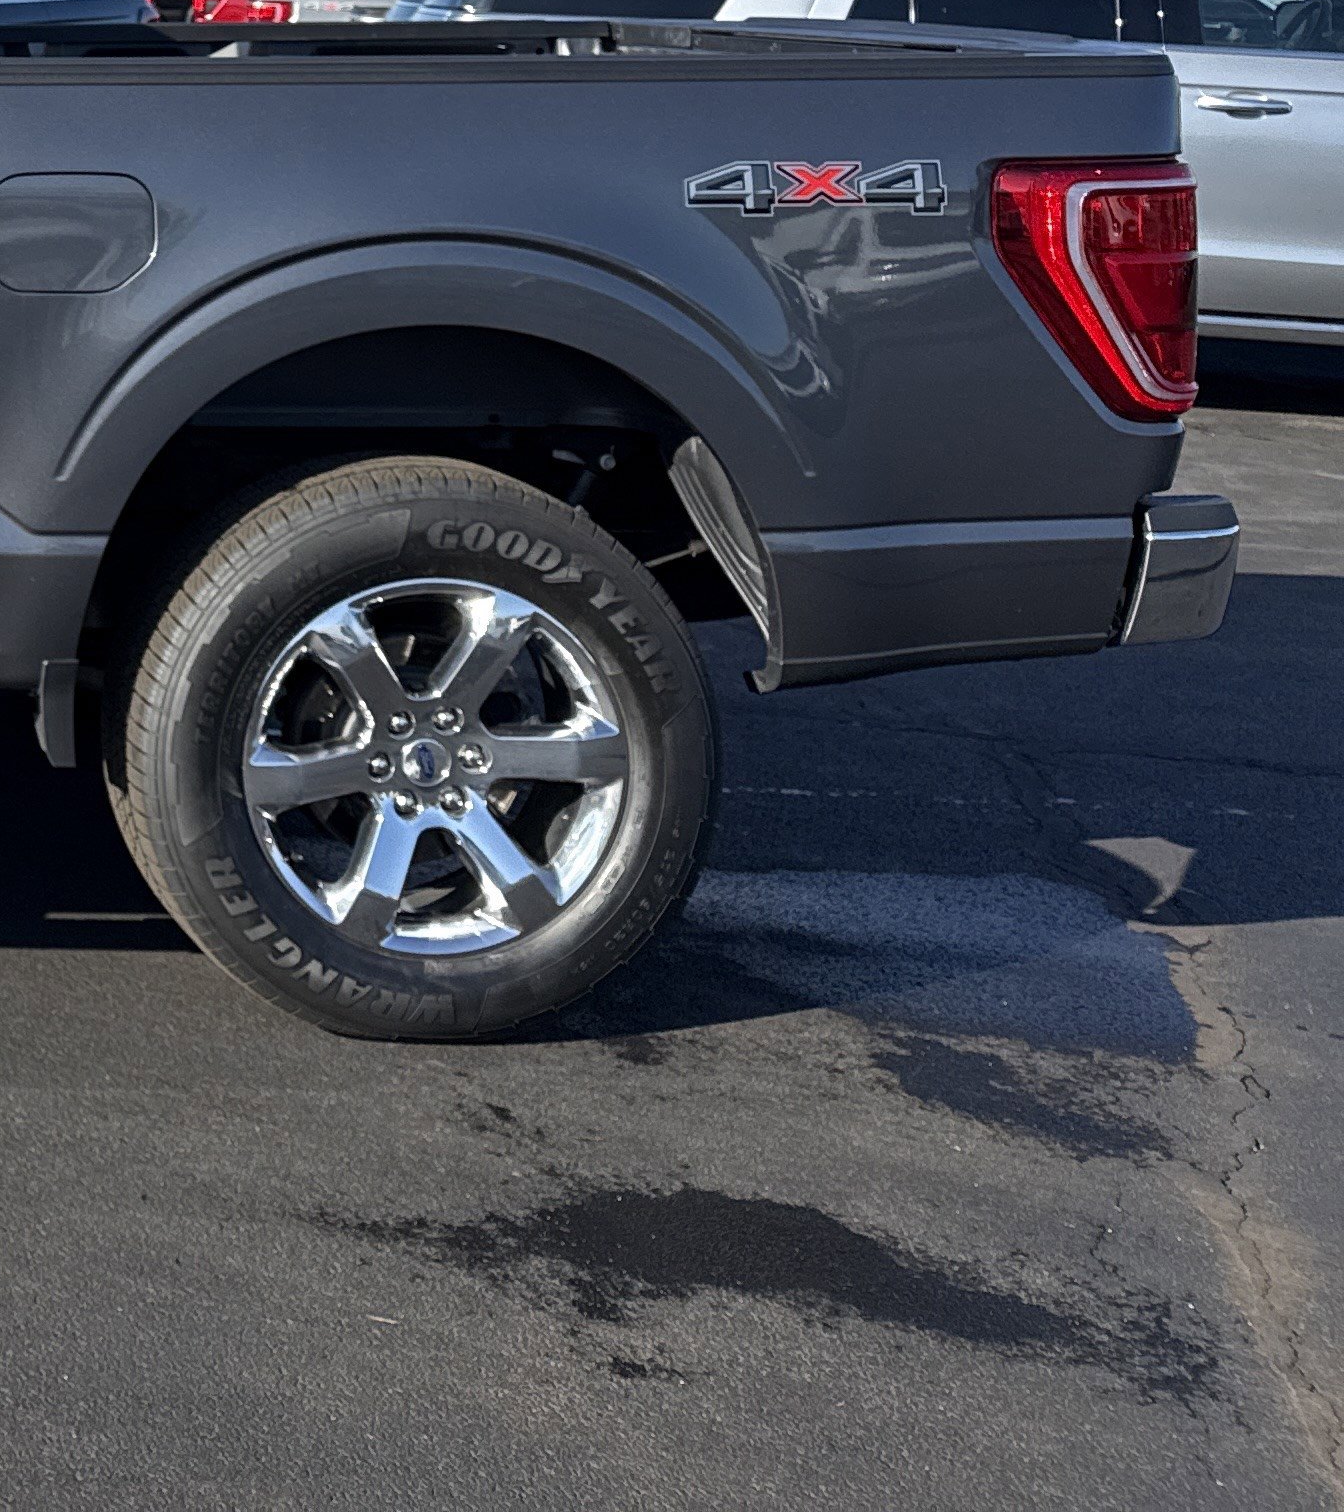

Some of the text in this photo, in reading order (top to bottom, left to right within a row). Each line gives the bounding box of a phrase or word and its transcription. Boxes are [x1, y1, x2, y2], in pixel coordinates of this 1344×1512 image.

[194, 595, 276, 745] TERRITORY
[426, 519, 683, 694] GOODYEAR
[204, 855, 456, 1026] WRANGLER
